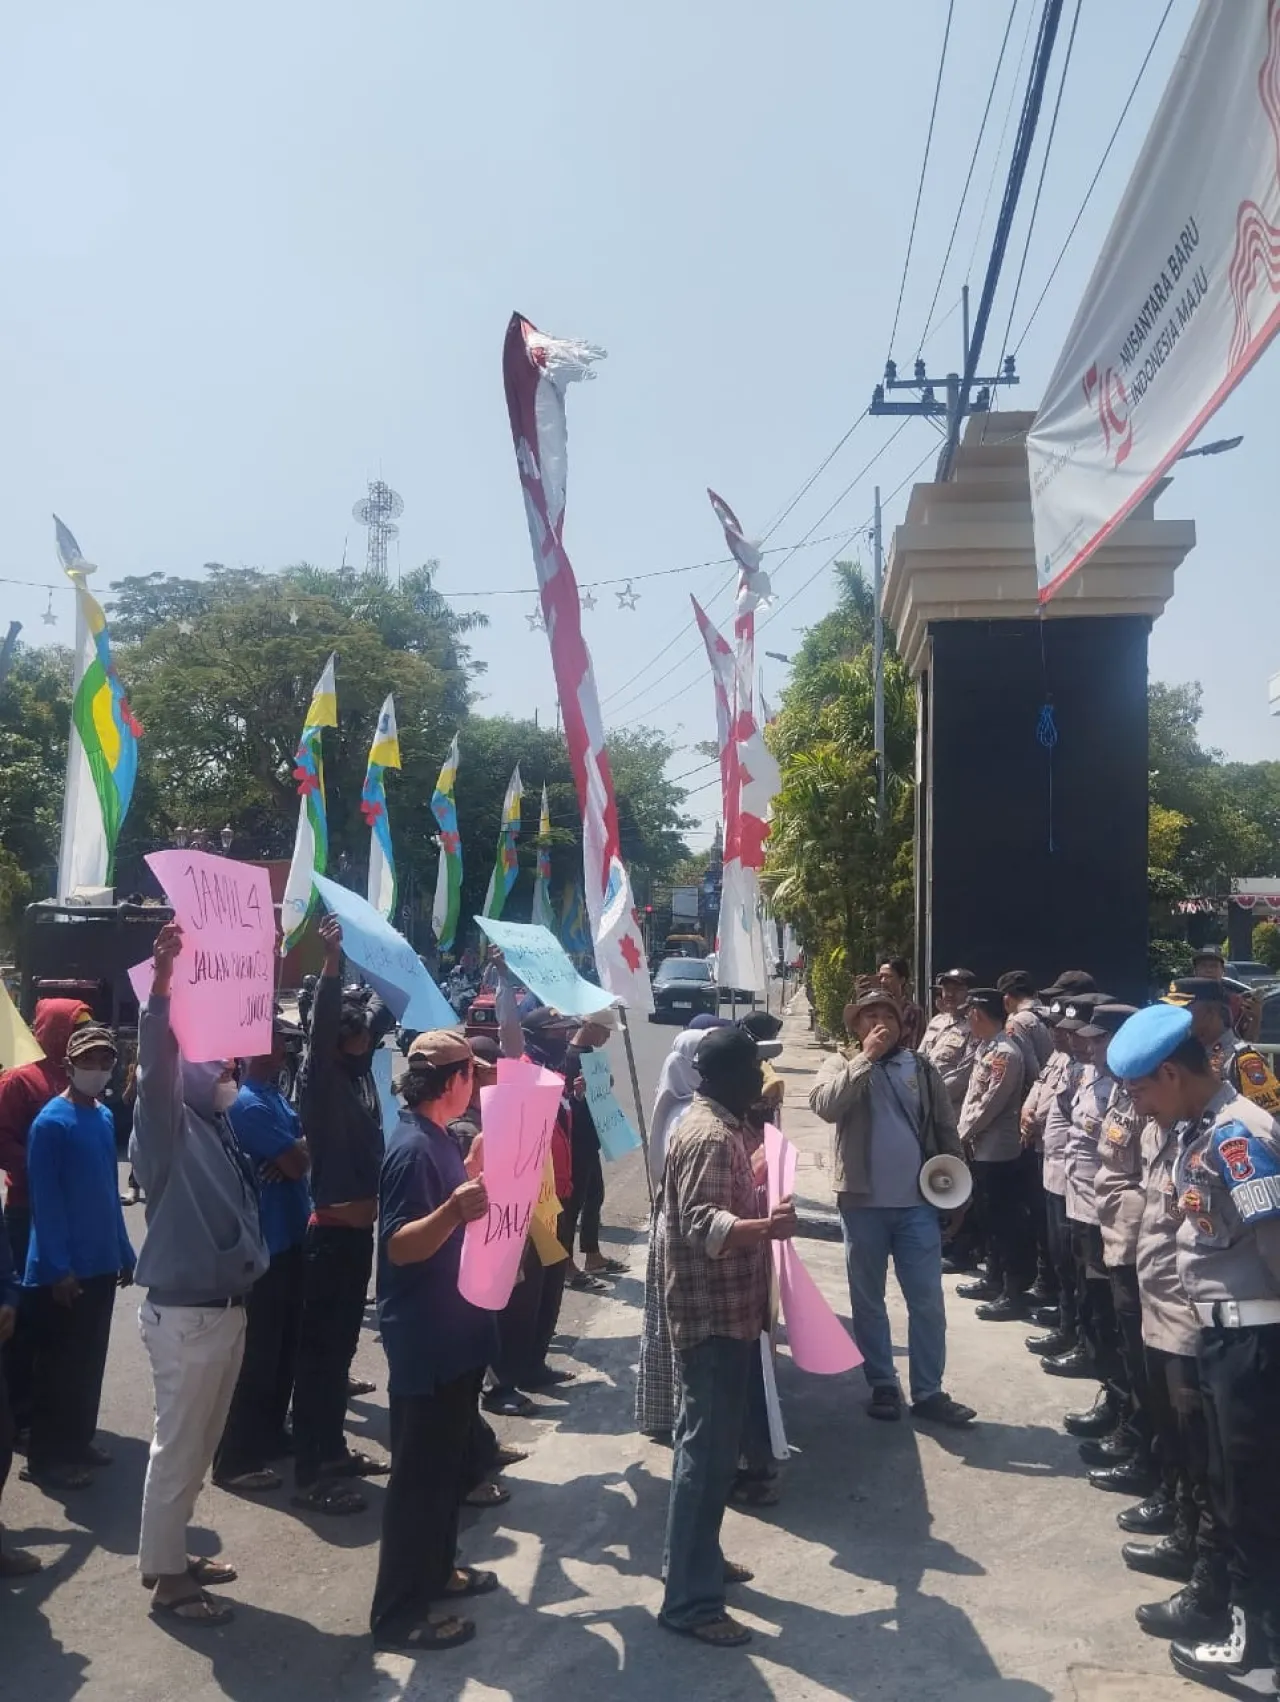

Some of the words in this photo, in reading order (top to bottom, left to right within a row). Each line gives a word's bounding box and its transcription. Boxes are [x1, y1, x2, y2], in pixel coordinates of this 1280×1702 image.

[1119, 270, 1175, 372] NUSANTARA
[1167, 215, 1200, 283] BARU
[1129, 318, 1181, 406] INDONESIA
[1175, 264, 1209, 331] MAJU
